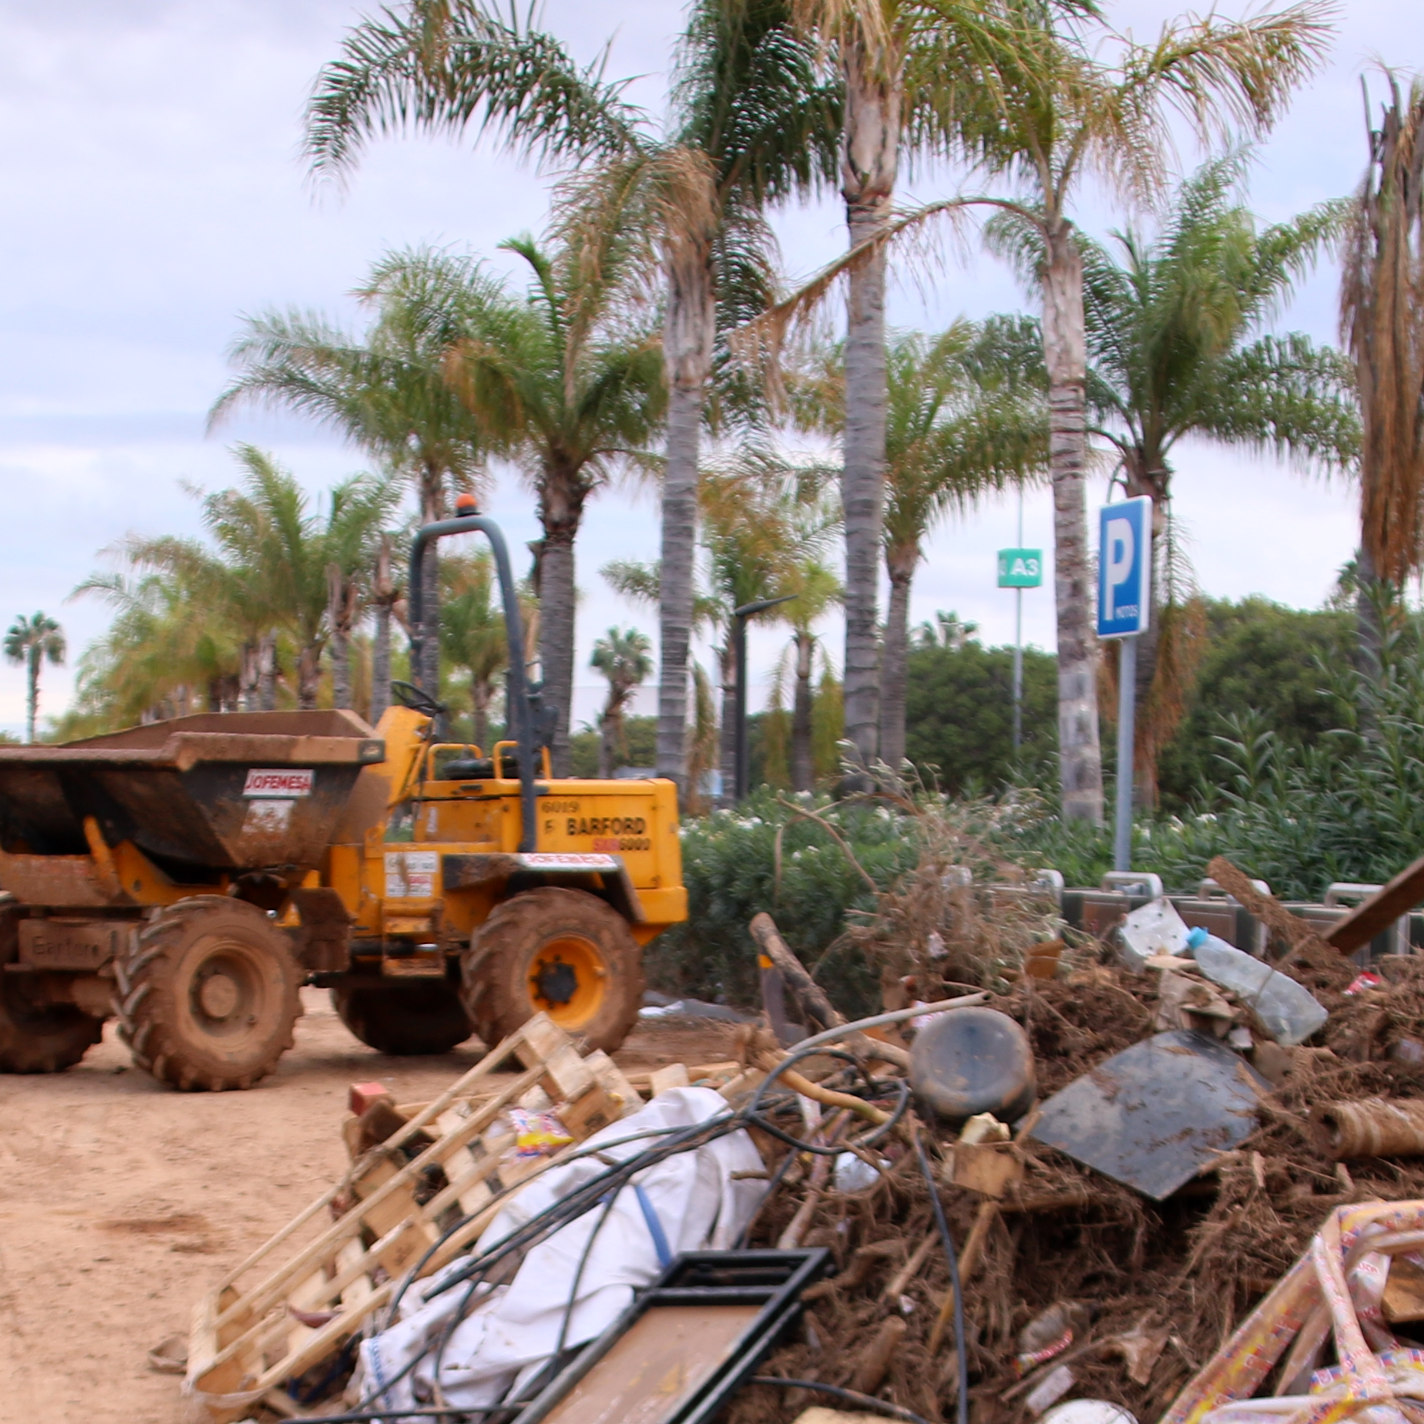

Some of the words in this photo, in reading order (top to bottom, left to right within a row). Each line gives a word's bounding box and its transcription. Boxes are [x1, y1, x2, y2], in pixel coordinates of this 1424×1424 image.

[1009, 557, 1040, 577] A3
[1104, 517, 1135, 621] P
[566, 817, 646, 836] BARFORD
